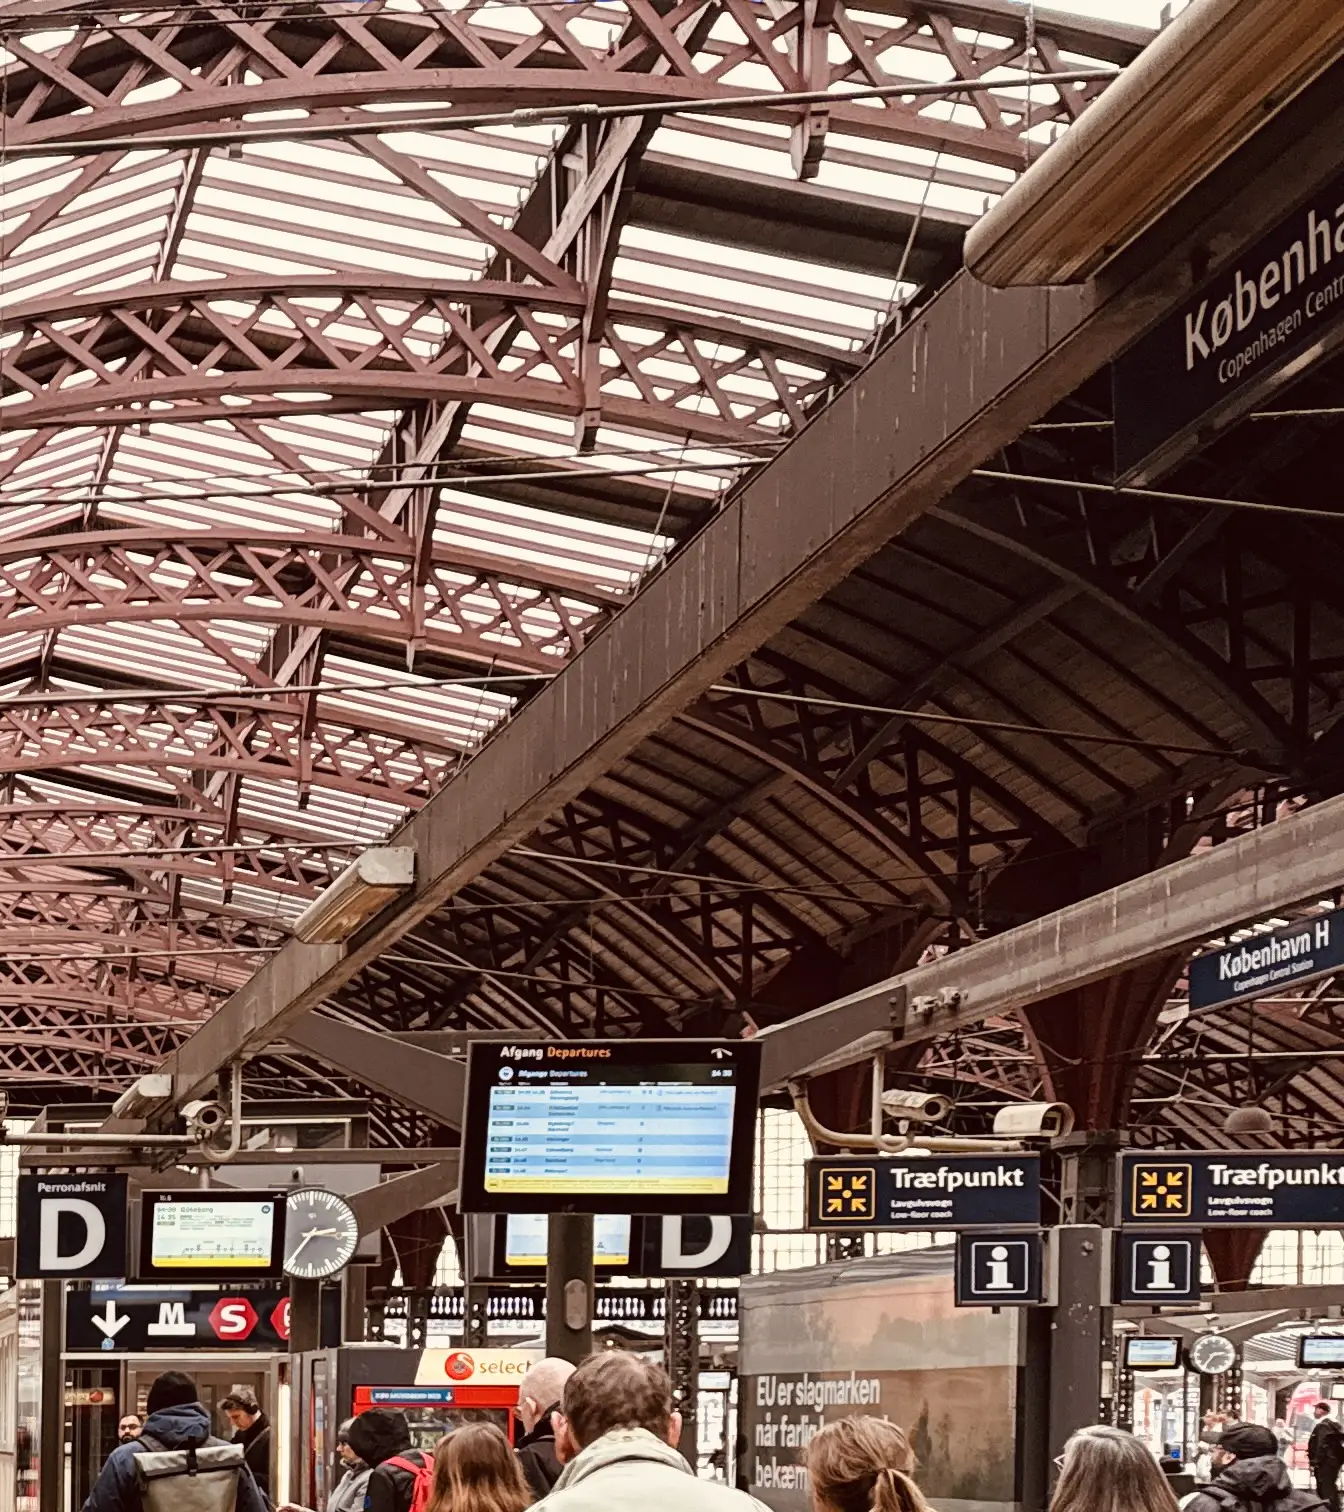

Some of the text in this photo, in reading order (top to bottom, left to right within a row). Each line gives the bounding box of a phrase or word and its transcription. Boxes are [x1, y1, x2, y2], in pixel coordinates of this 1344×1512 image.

[1219, 309, 1301, 384] Copenhagen
[1219, 919, 1330, 980] København H
[500, 1046, 612, 1060] Afgang Departures
[37, 1181, 107, 1193] Perronafsnit
[890, 1166, 1024, 1192] Træfpunkt
[890, 1199, 953, 1209] Lavgulvsvogn
[890, 1210, 953, 1219] Low-floor coach
[1208, 1196, 1273, 1206] Lavgulvsvogn
[1208, 1207, 1273, 1217] Low-floor coach
[39, 1198, 106, 1270] D
[661, 1214, 732, 1269] D
[219, 1305, 247, 1333] S
[756, 1370, 881, 1412] EU er slagmarken
[755, 1412, 779, 1447] når
